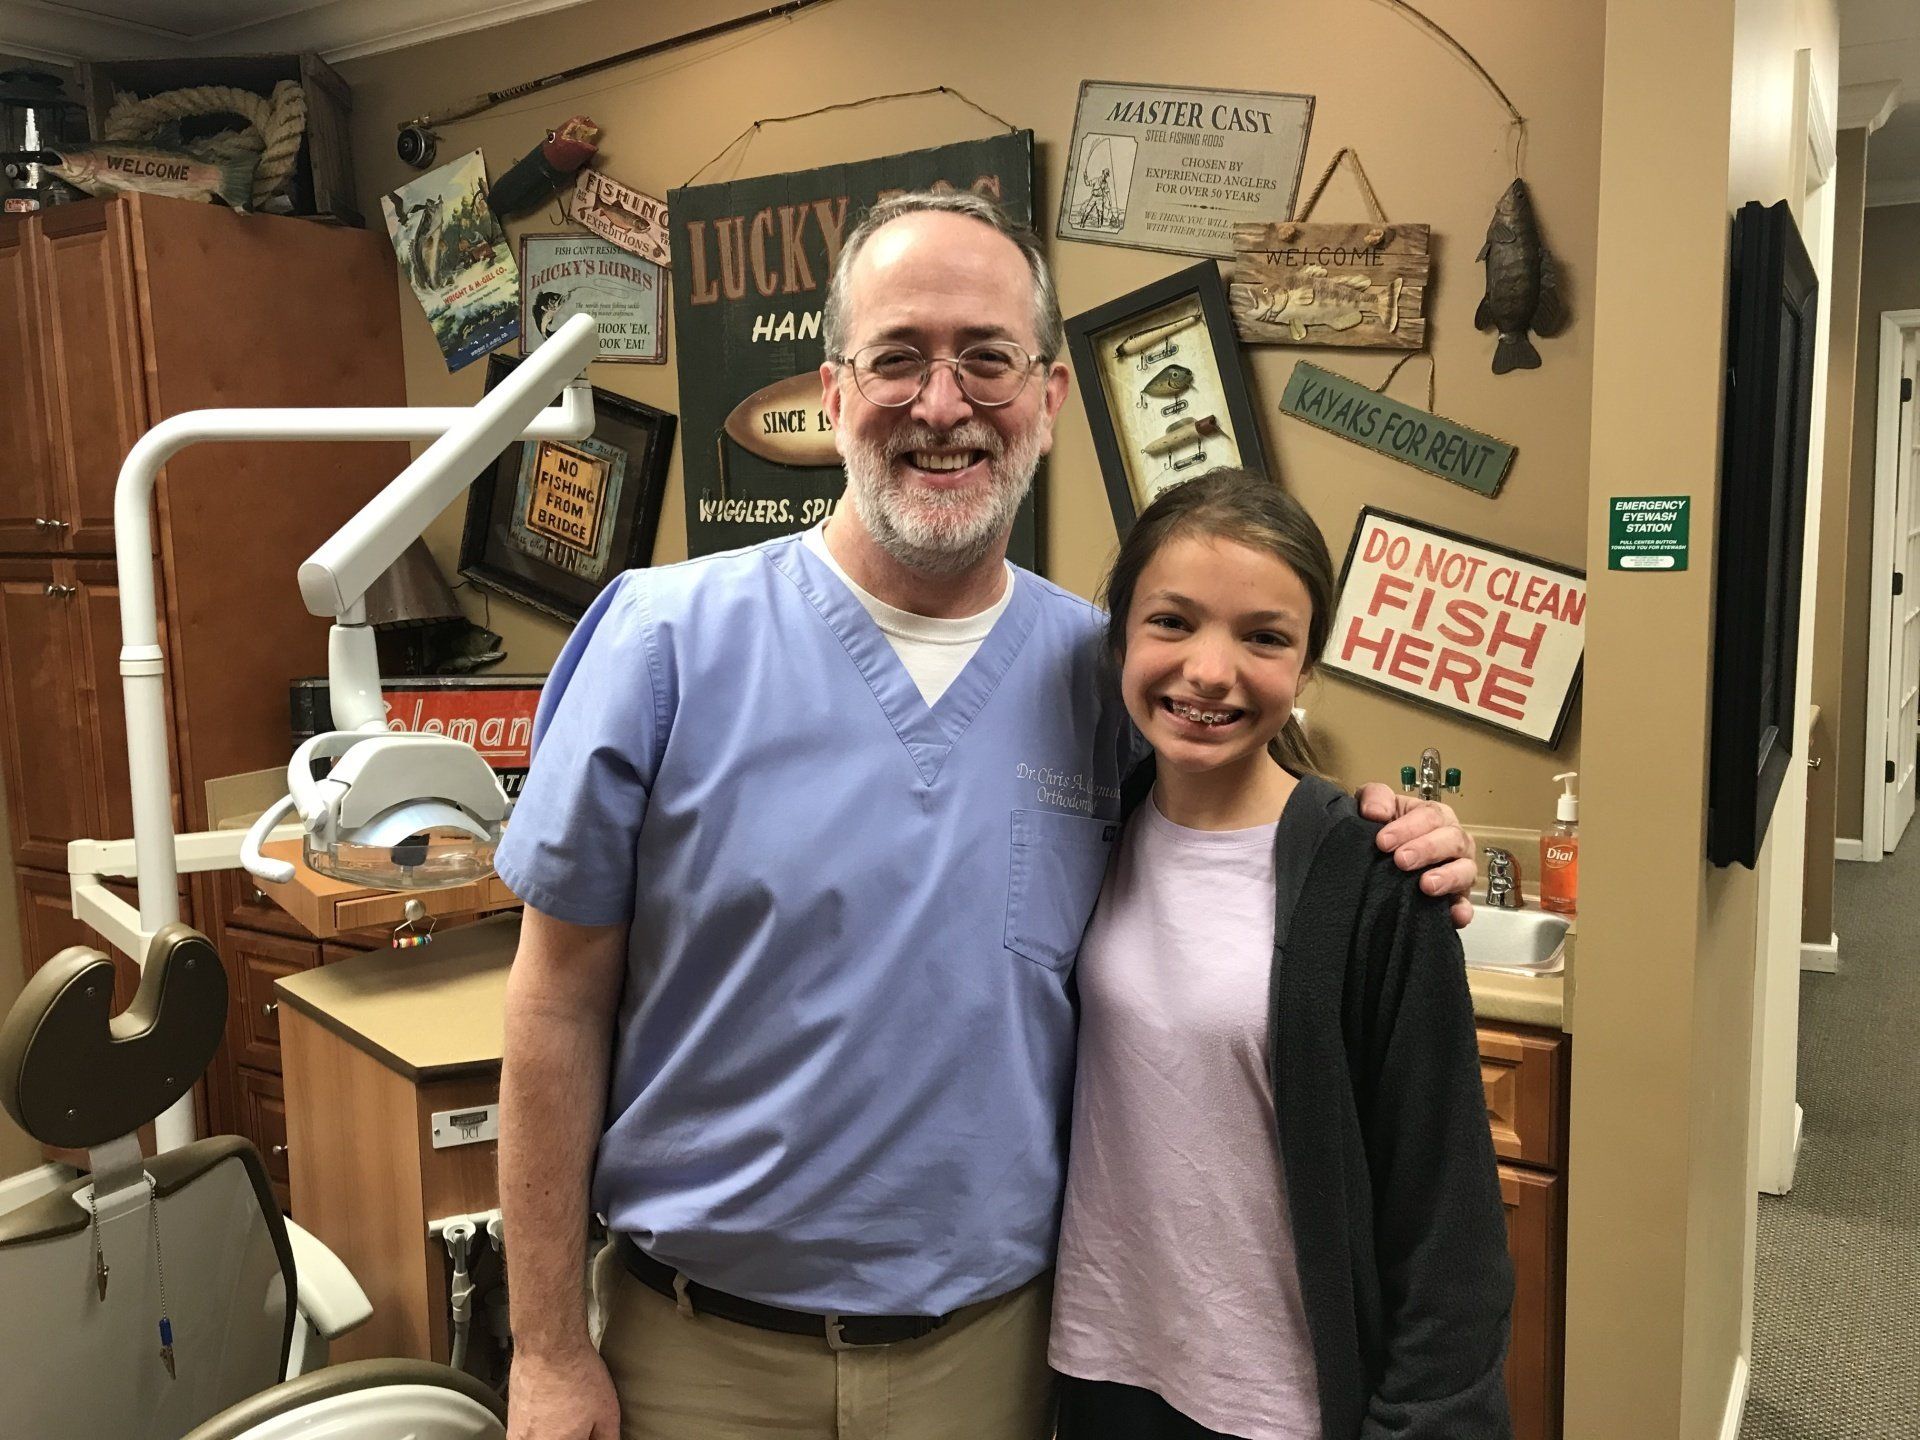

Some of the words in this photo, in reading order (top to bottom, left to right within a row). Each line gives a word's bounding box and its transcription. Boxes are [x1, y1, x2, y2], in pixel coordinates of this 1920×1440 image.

[1105, 100, 1204, 129] MASTER
[1212, 104, 1274, 134] CAST
[1145, 129, 1168, 143] STEEL
[1169, 131, 1201, 146] FISHING
[1202, 134, 1225, 148] RODS
[107, 155, 190, 181] WELCOME
[1181, 156, 1227, 171] CHOSEN
[1228, 160, 1244, 172] BY
[1145, 167, 1222, 186] EXPERIENCED
[1223, 176, 1277, 190] ANGLERS
[1155, 182, 1175, 195] FOR
[1176, 185, 1210, 197] OVER
[1210, 188, 1223, 199] 50
[1225, 189, 1261, 203] YEARS
[586, 213, 650, 253] EXPEDITIONS
[1145, 211, 1157, 220] WE
[1159, 212, 1187, 224] THINK
[1187, 216, 1206, 224] YOU
[1207, 217, 1230, 229] WILL
[1146, 222, 1169, 232] WITH
[1169, 225, 1196, 236] THEIR
[555, 246, 571, 256] FISH
[573, 246, 595, 256] CAN'T
[686, 195, 850, 306] LUCKY
[1266, 247, 1386, 268] WELCOME
[443, 287, 468, 305] WRIGHT
[468, 283, 475, 291] &
[495, 266, 508, 276] CO.
[530, 258, 595, 290] LUCKY'S
[598, 259, 653, 291] LURES
[597, 322, 627, 336] HOOK
[629, 322, 651, 336] 'EM,
[752, 311, 822, 342] HAN
[599, 338, 621, 349] OOK
[623, 337, 645, 350] 'EM!
[763, 409, 806, 434] SINCE
[1294, 378, 1382, 438] KAYAKS
[1377, 412, 1428, 457] FOR
[1424, 430, 1496, 480] RENT
[558, 458, 579, 478] NO
[540, 470, 595, 503] FISHING
[545, 492, 584, 519] FROM
[699, 498, 794, 524] WIGGLERS,
[1615, 500, 1687, 511] EMERGENCY
[1622, 512, 1678, 522] EYEWASH
[537, 509, 587, 541] BRIDGE
[1626, 523, 1673, 533] STATION
[544, 537, 579, 572] FUN
[1361, 527, 1411, 571] DO
[1413, 542, 1488, 593] NOT
[1486, 566, 1586, 627] CLEAN
[1367, 573, 1547, 669] FISH
[1340, 616, 1534, 721] HERE
[383, 698, 531, 747] oleman
[1016, 762, 1036, 780] Dr.
[1038, 767, 1070, 787] Chris
[1071, 774, 1086, 791] A.
[1547, 847, 1574, 862] Dial
[462, 1126, 479, 1140] DCI
